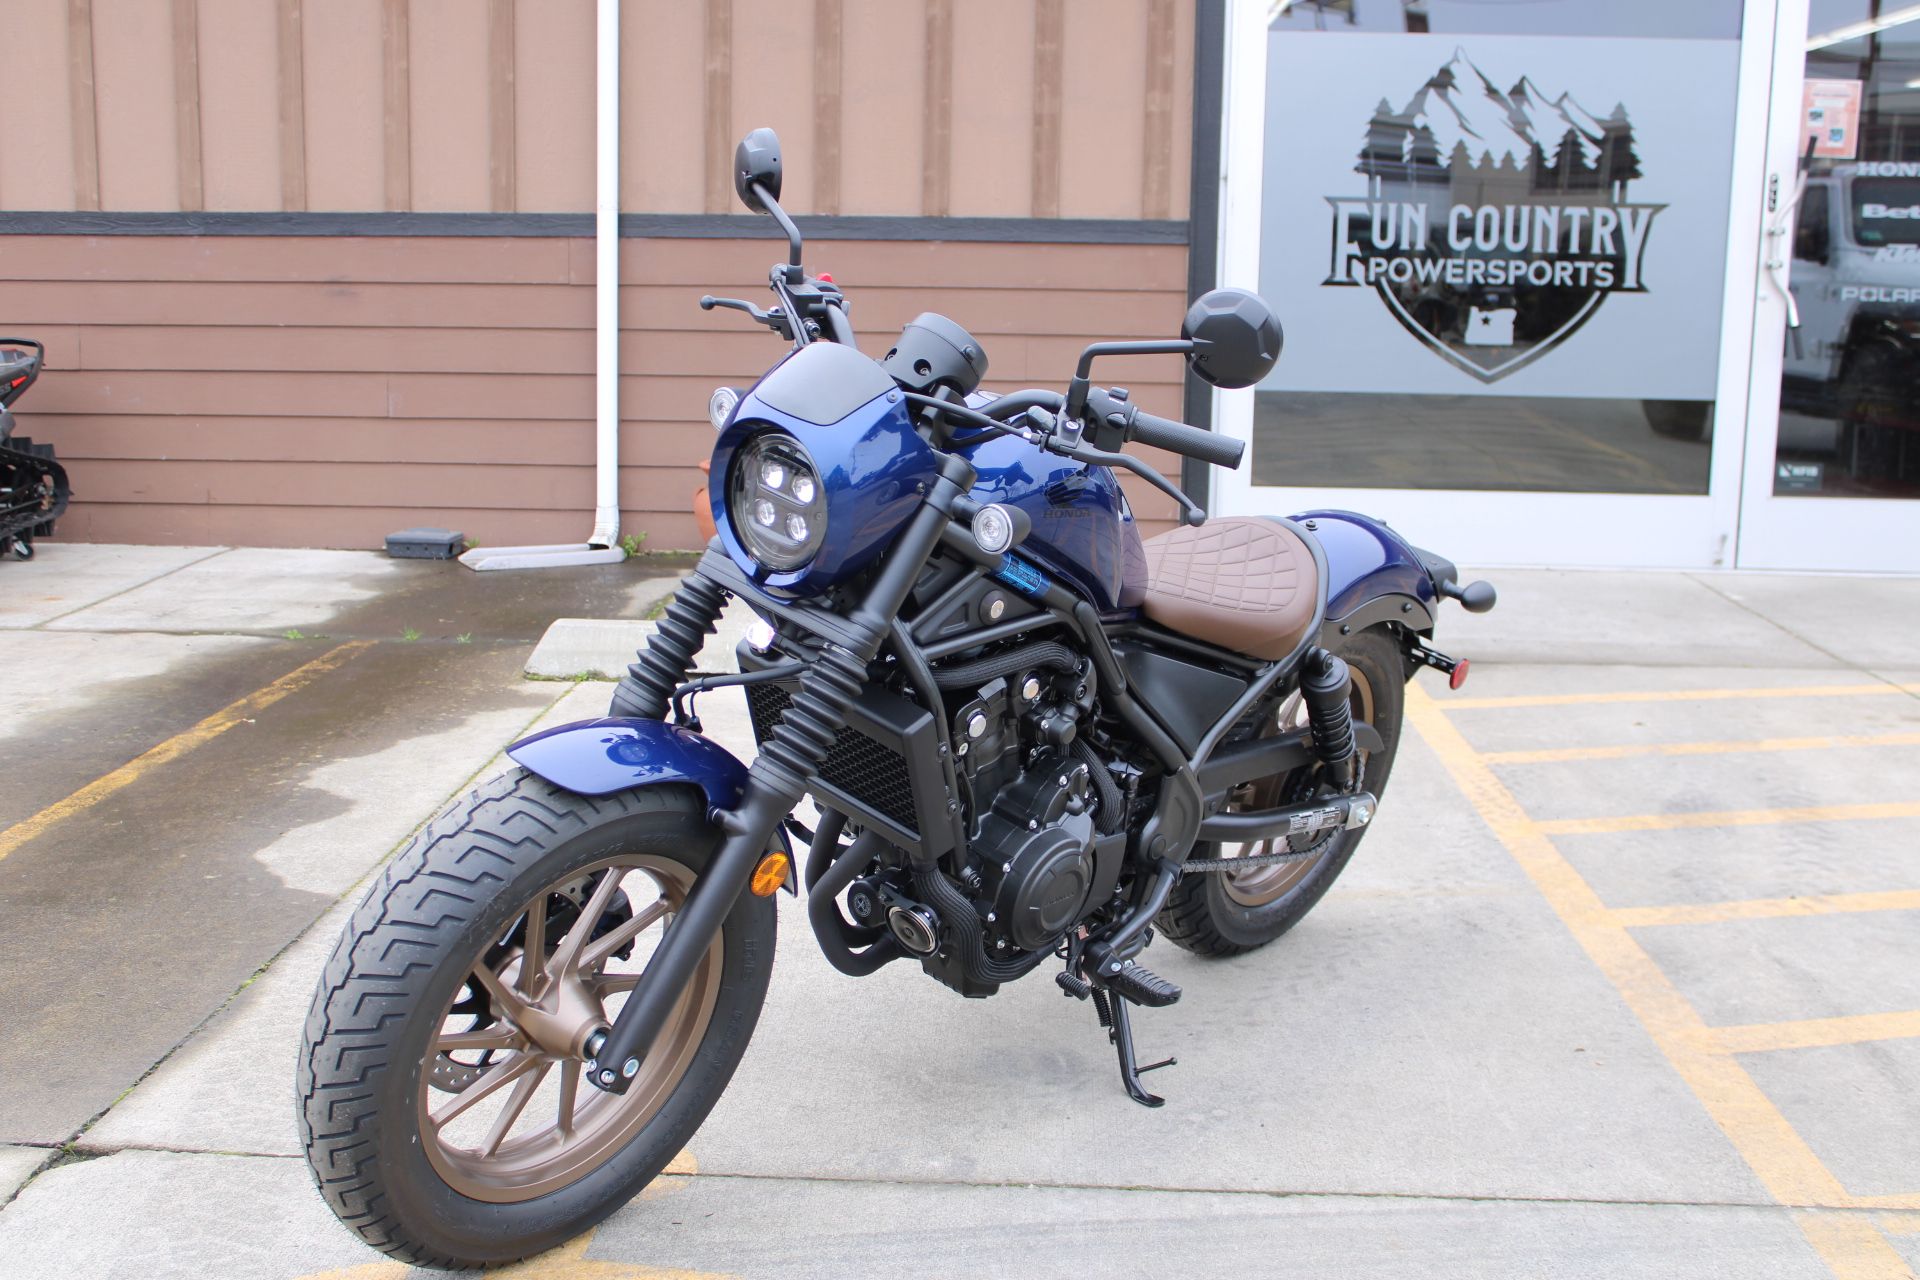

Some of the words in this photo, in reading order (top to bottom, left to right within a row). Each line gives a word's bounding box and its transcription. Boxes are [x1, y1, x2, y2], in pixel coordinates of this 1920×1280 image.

[1857, 161, 1920, 177] HON
[1332, 202, 1428, 282] FUN
[1448, 203, 1654, 289] COUNTRY
[1368, 256, 1615, 288] POWERSPORTS
[1043, 508, 1090, 519] HONDA
